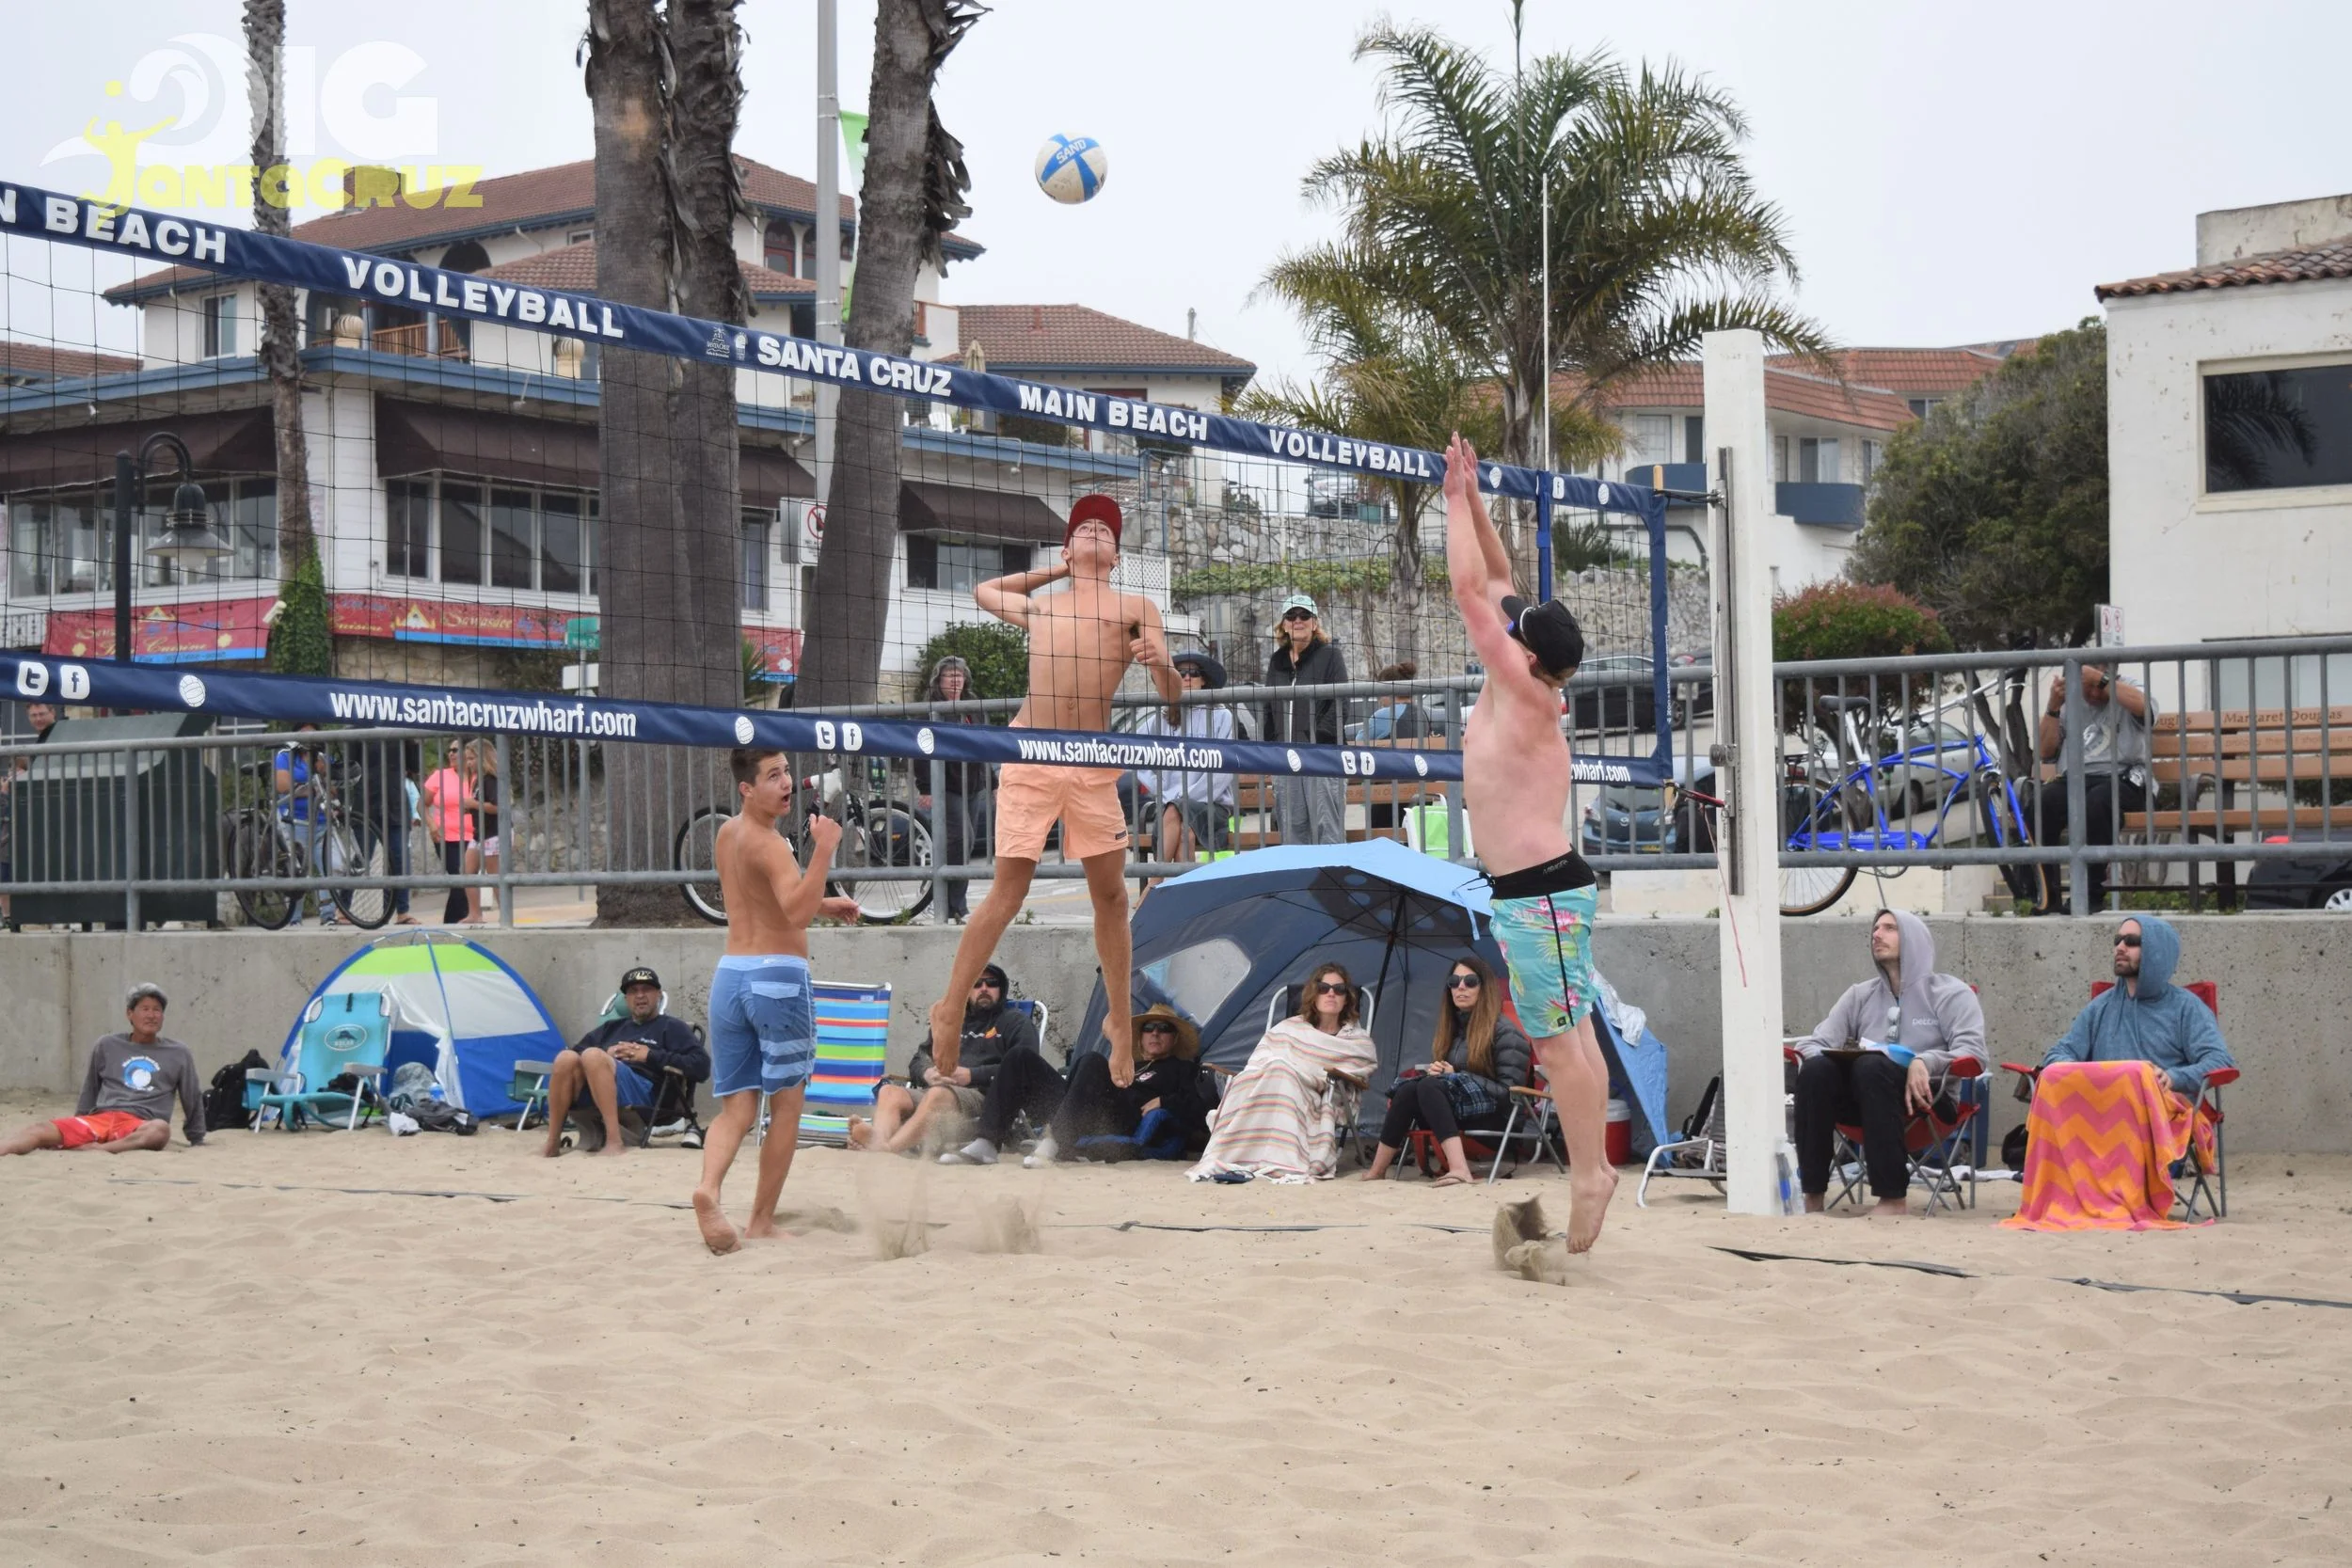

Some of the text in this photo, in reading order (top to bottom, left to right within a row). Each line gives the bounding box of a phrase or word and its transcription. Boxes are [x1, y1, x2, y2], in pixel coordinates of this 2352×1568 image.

[1056, 140, 1088, 165] SAND
[45, 197, 227, 264] BEACH
[342, 256, 624, 339] VOLLEYBALL
[757, 336, 1431, 478] SANTA CRUZ MAIN BEACH VOLLEYBALL
[329, 691, 637, 737] www.santacruzwharf.com
[2223, 712, 2284, 724] Mararet
[2291, 709, 2344, 723] Dougas
[1017, 738, 1223, 768] www.santacruzwharf.com
